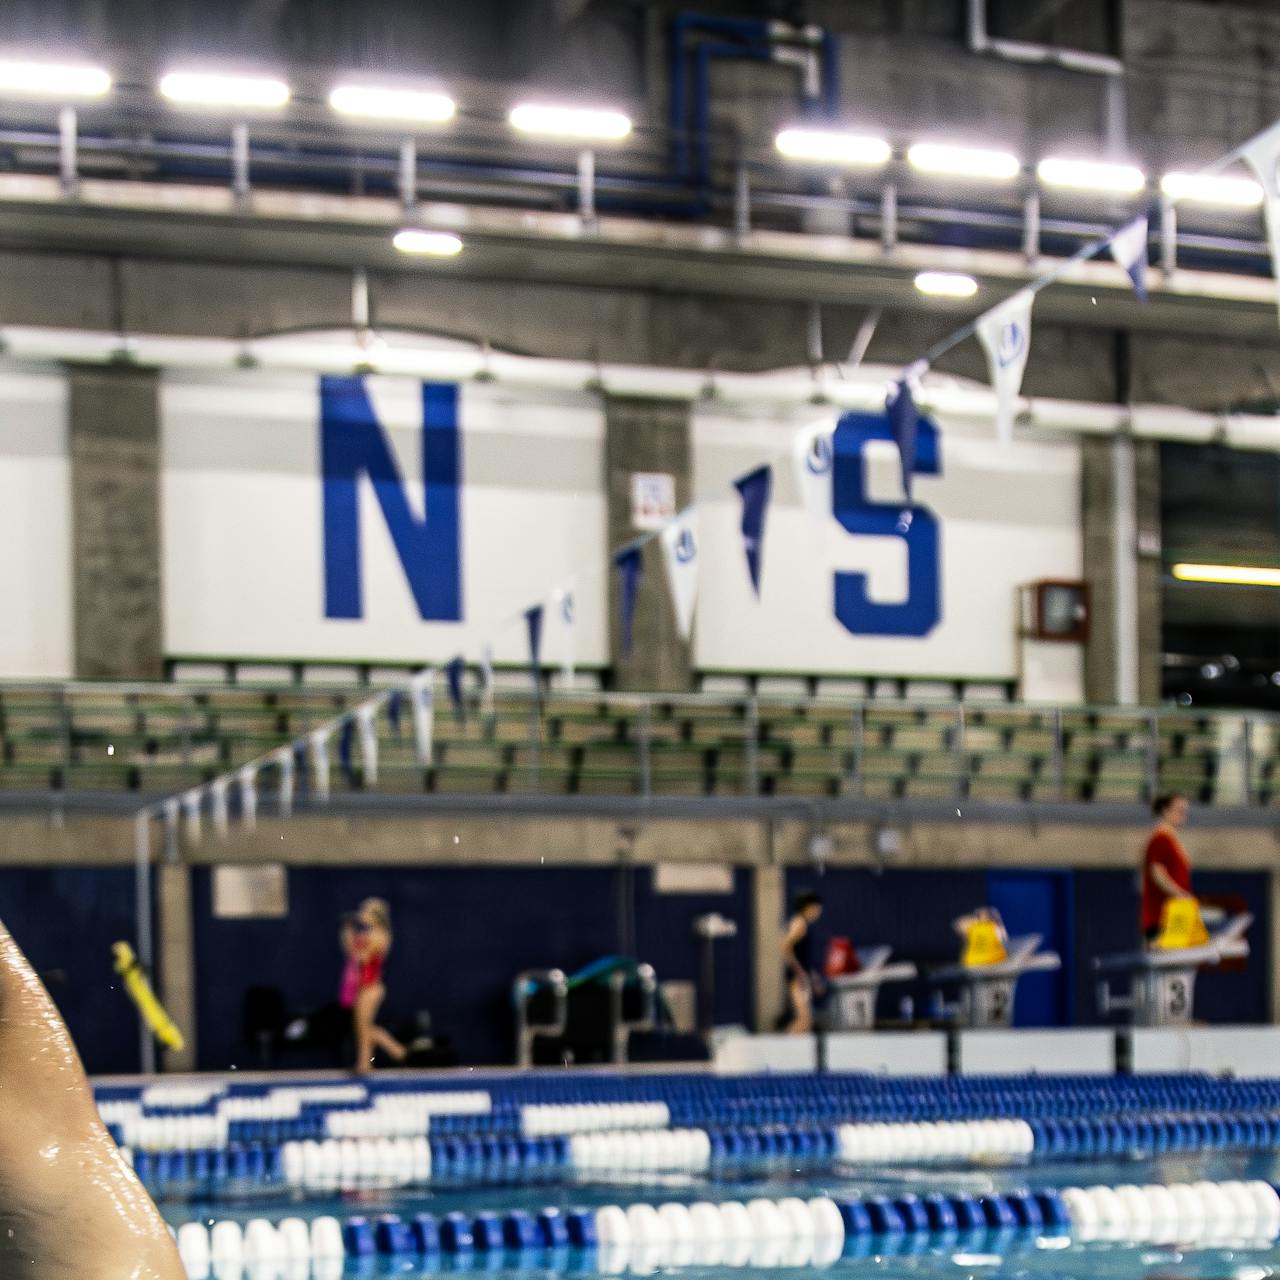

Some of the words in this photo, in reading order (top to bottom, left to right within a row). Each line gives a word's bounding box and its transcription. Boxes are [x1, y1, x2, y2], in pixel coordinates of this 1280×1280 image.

[319, 374, 463, 621] N
[832, 410, 943, 636] S
[1169, 979, 1186, 1017] 3
